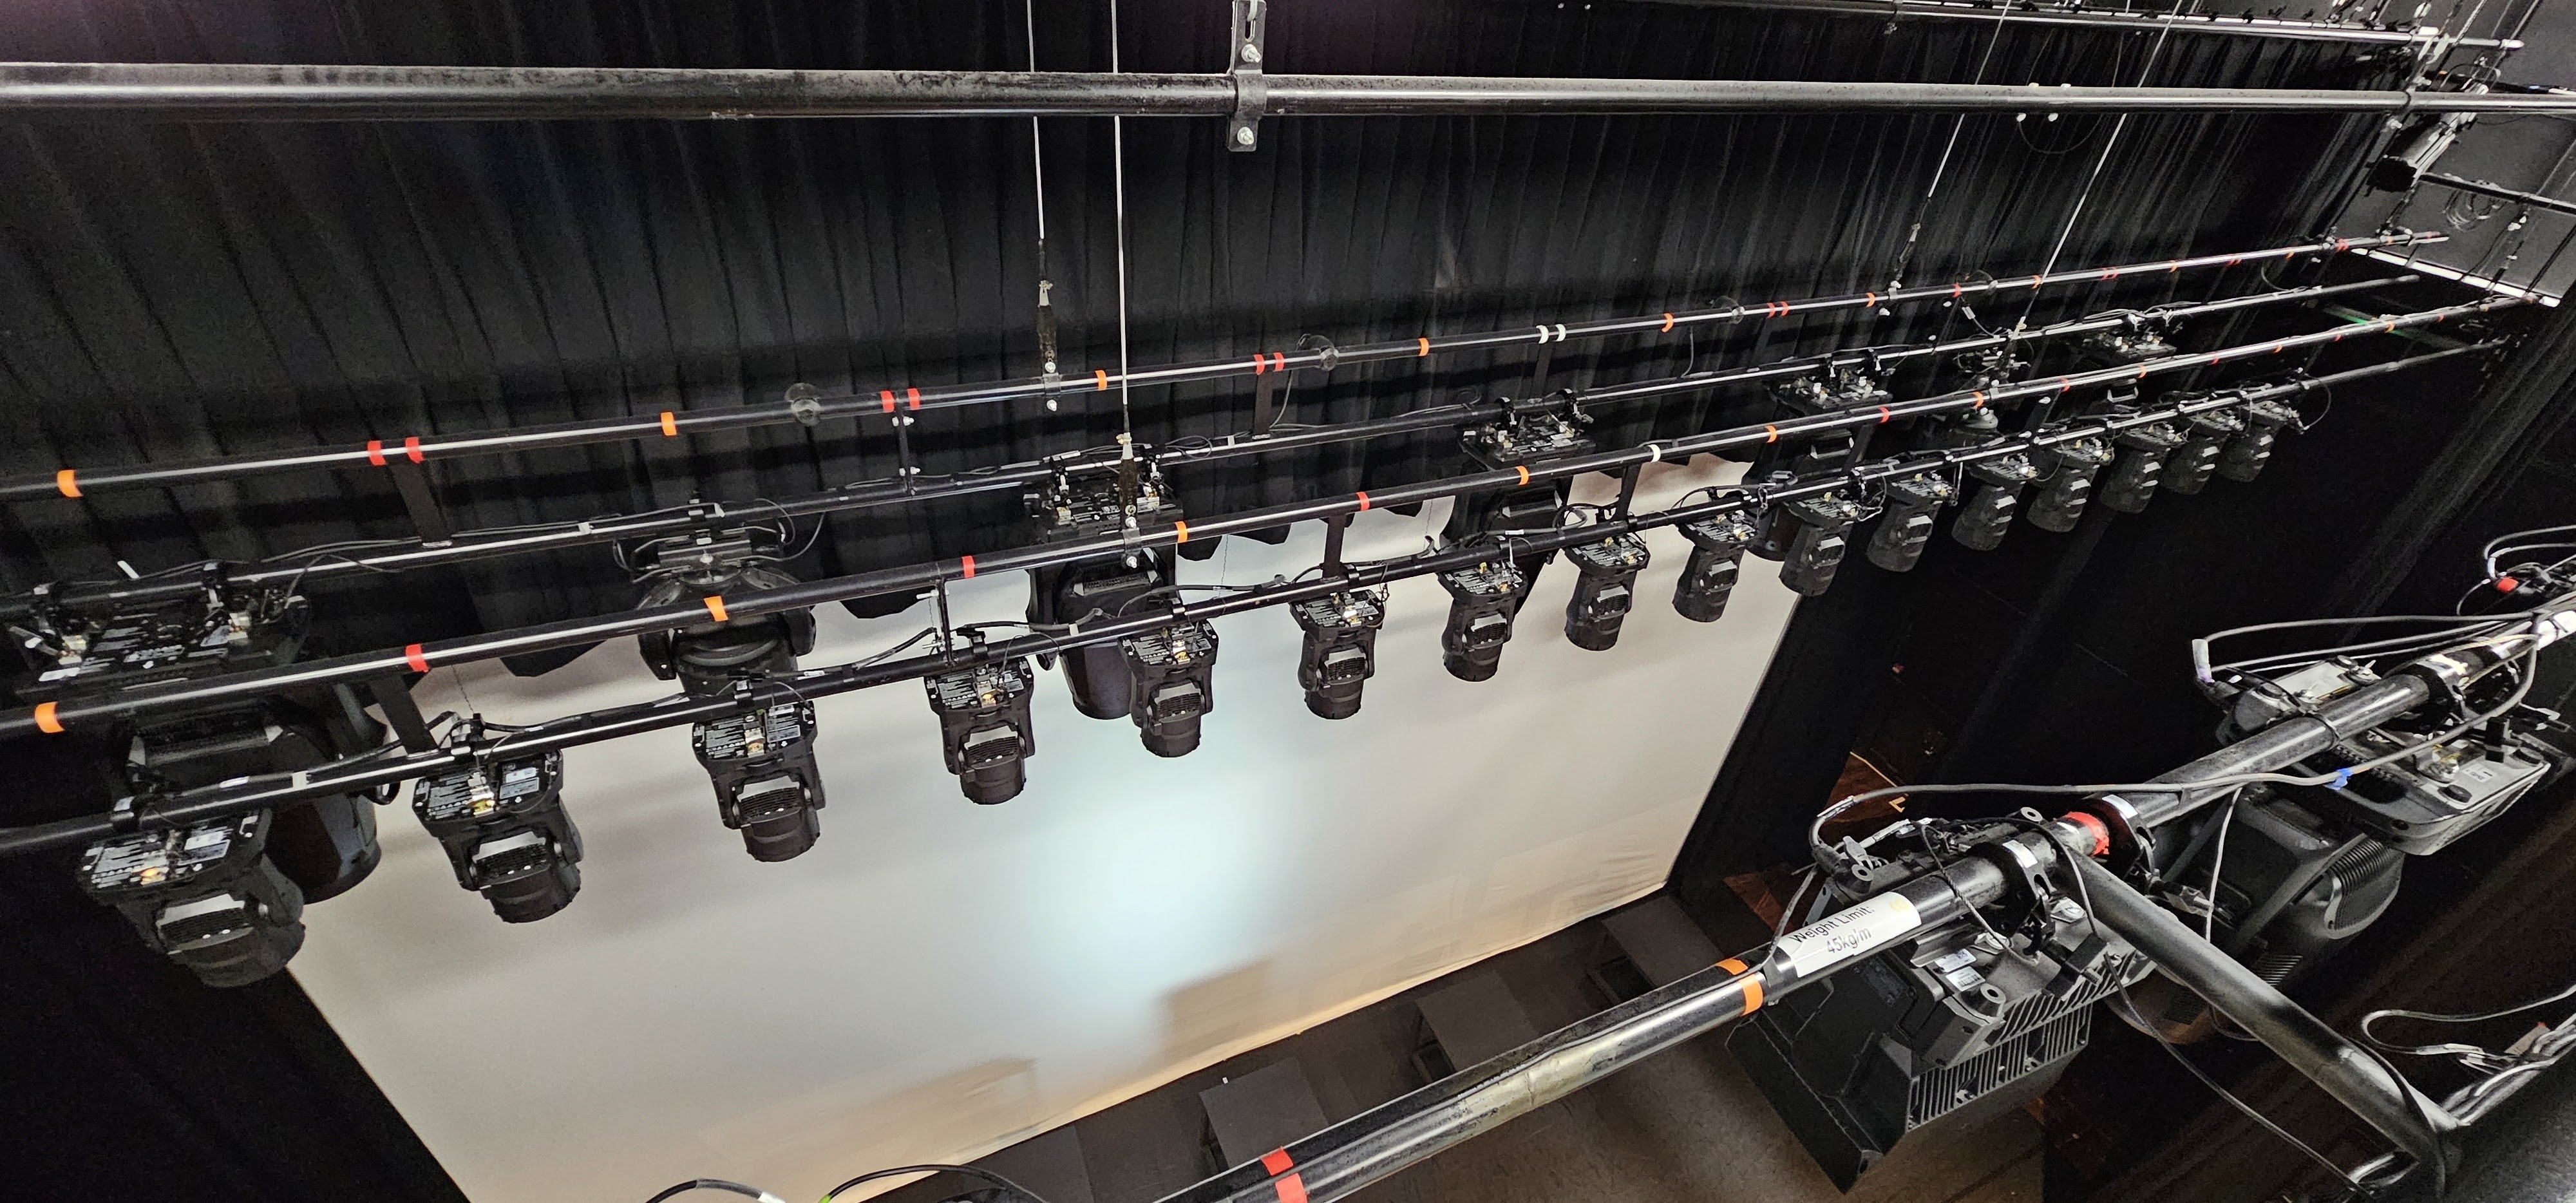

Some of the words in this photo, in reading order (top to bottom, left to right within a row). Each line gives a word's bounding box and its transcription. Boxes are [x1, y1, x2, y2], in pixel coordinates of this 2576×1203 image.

[1789, 921, 1840, 943] Weight
[1835, 905, 1875, 924] Limit:
[1826, 927, 1872, 953] 45kg/m
